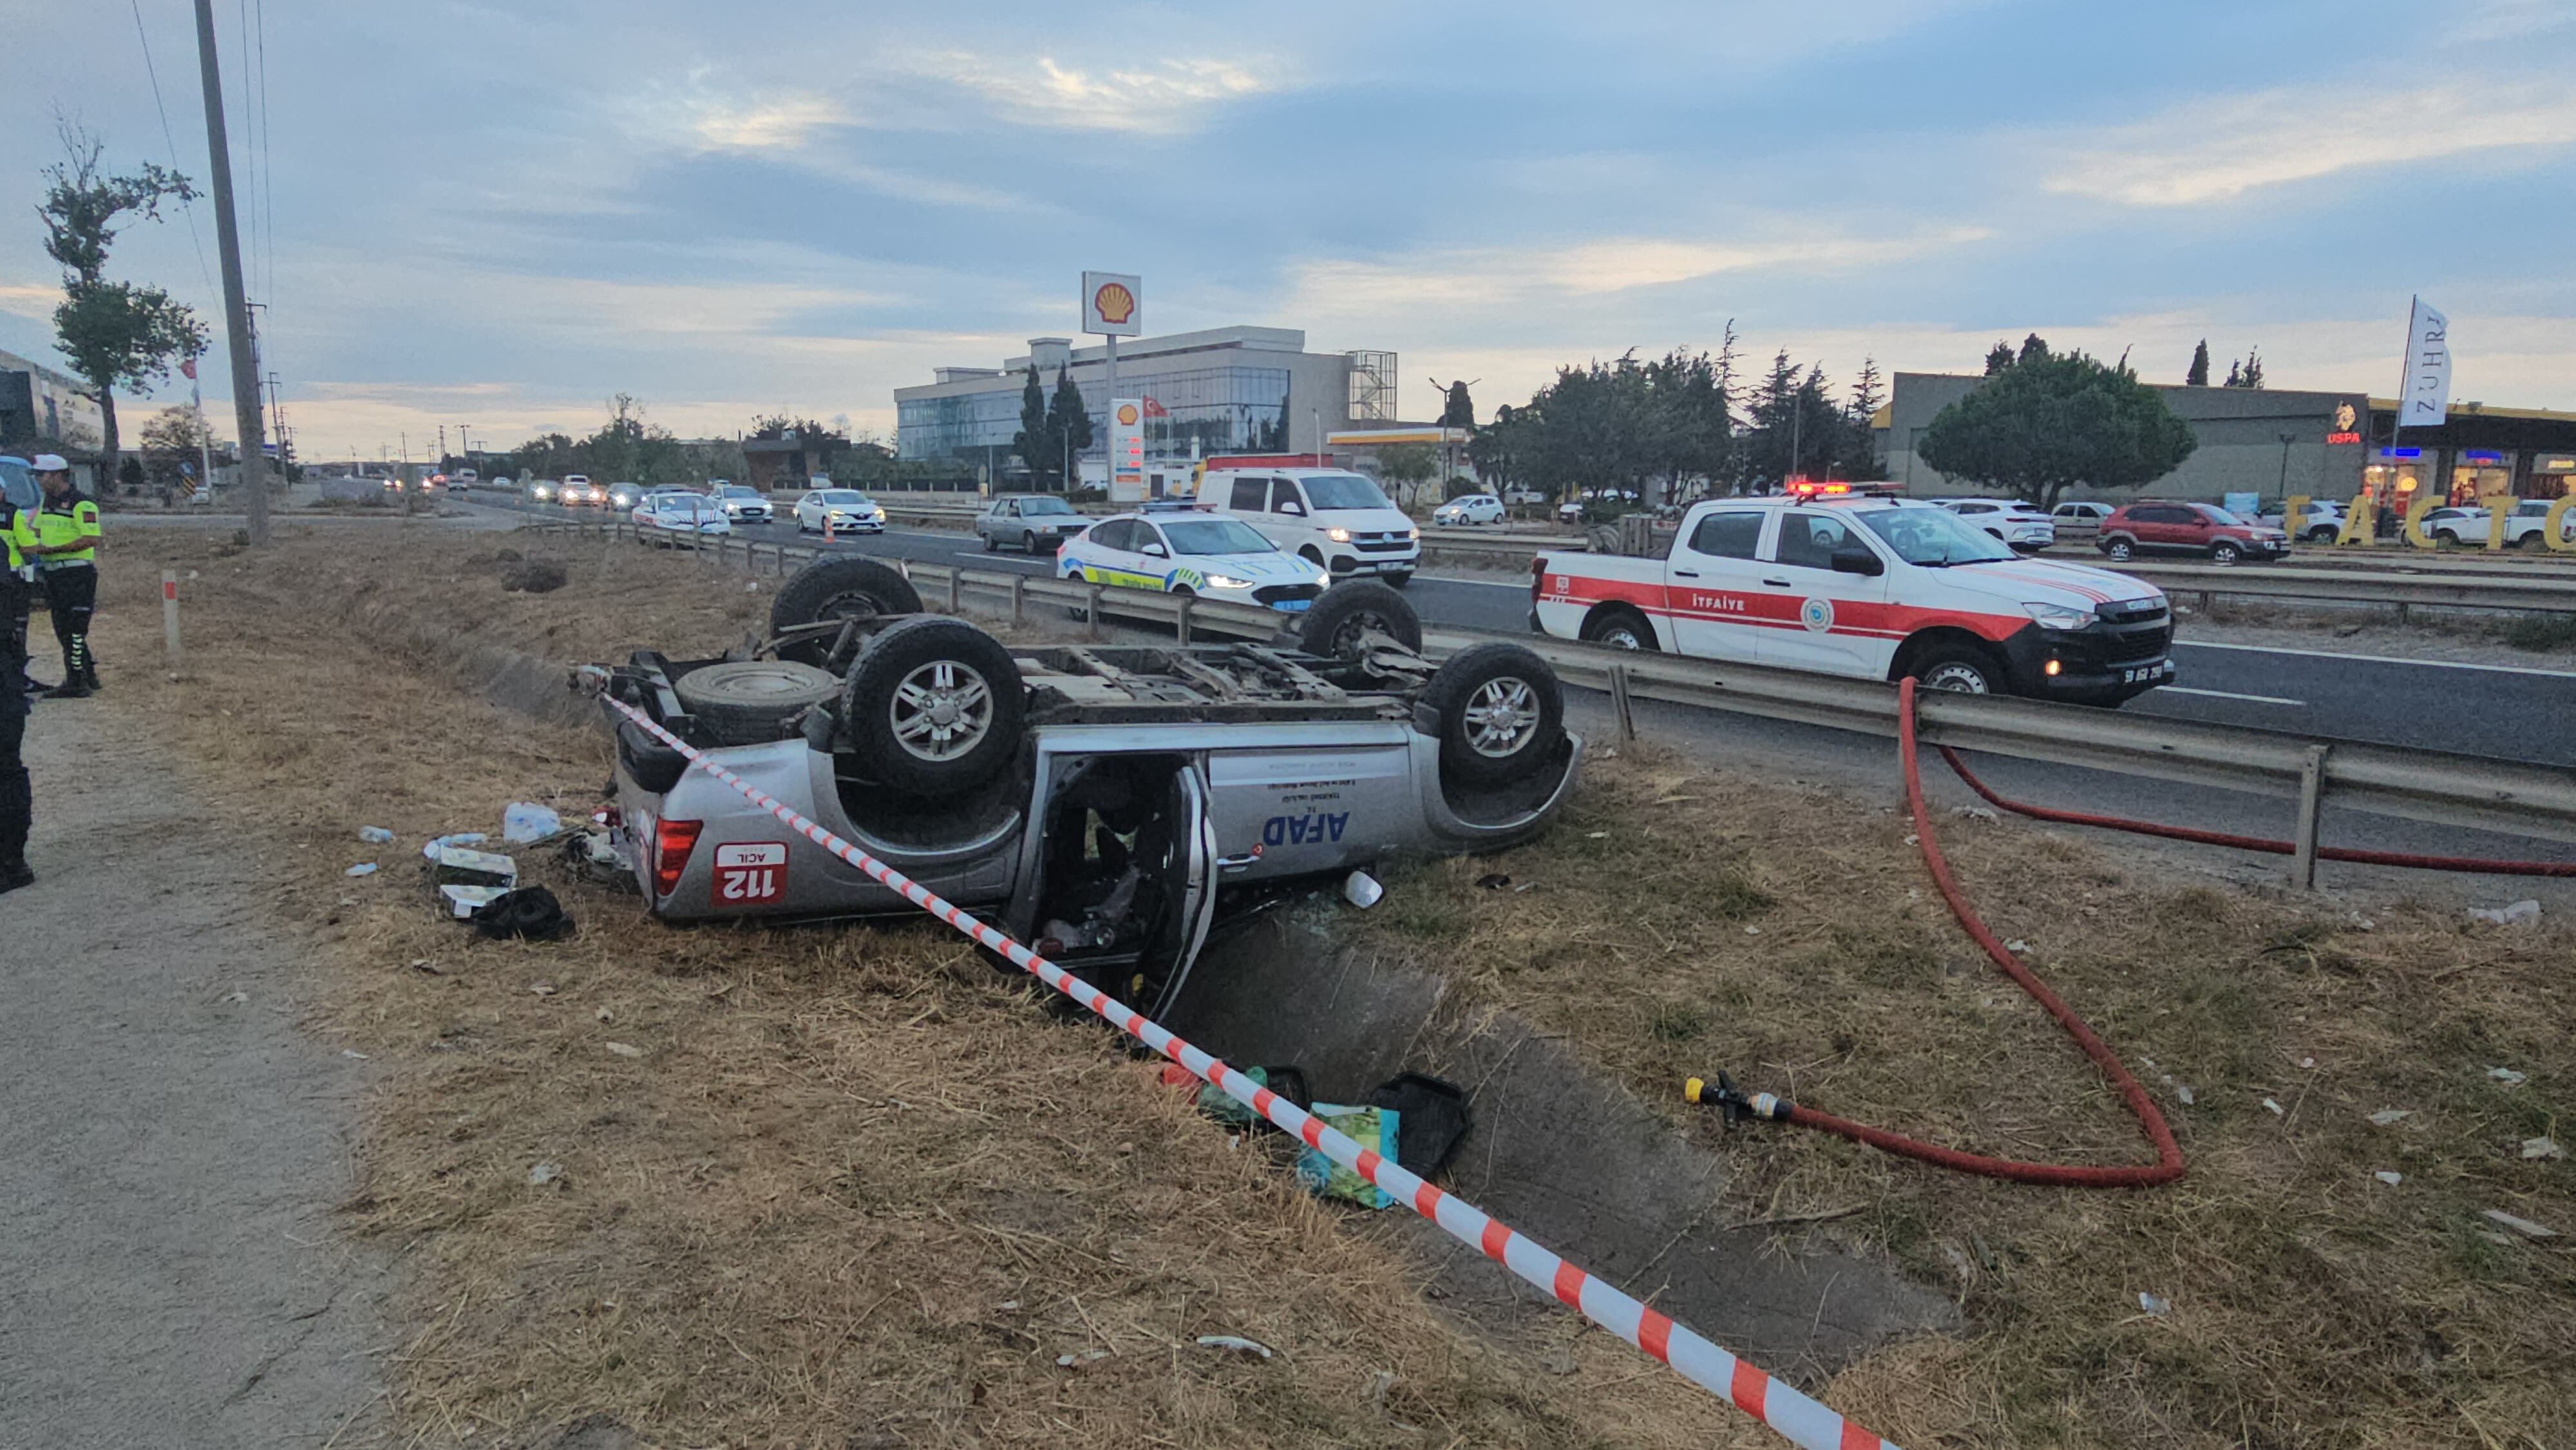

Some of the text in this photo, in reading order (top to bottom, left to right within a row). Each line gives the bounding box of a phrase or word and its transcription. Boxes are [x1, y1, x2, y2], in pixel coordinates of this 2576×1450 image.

[2327, 433, 2360, 444] USPA
[1692, 593, 1745, 611] İTFAİYE
[1263, 812, 1349, 846] AFAD
[724, 870, 775, 899] 112
